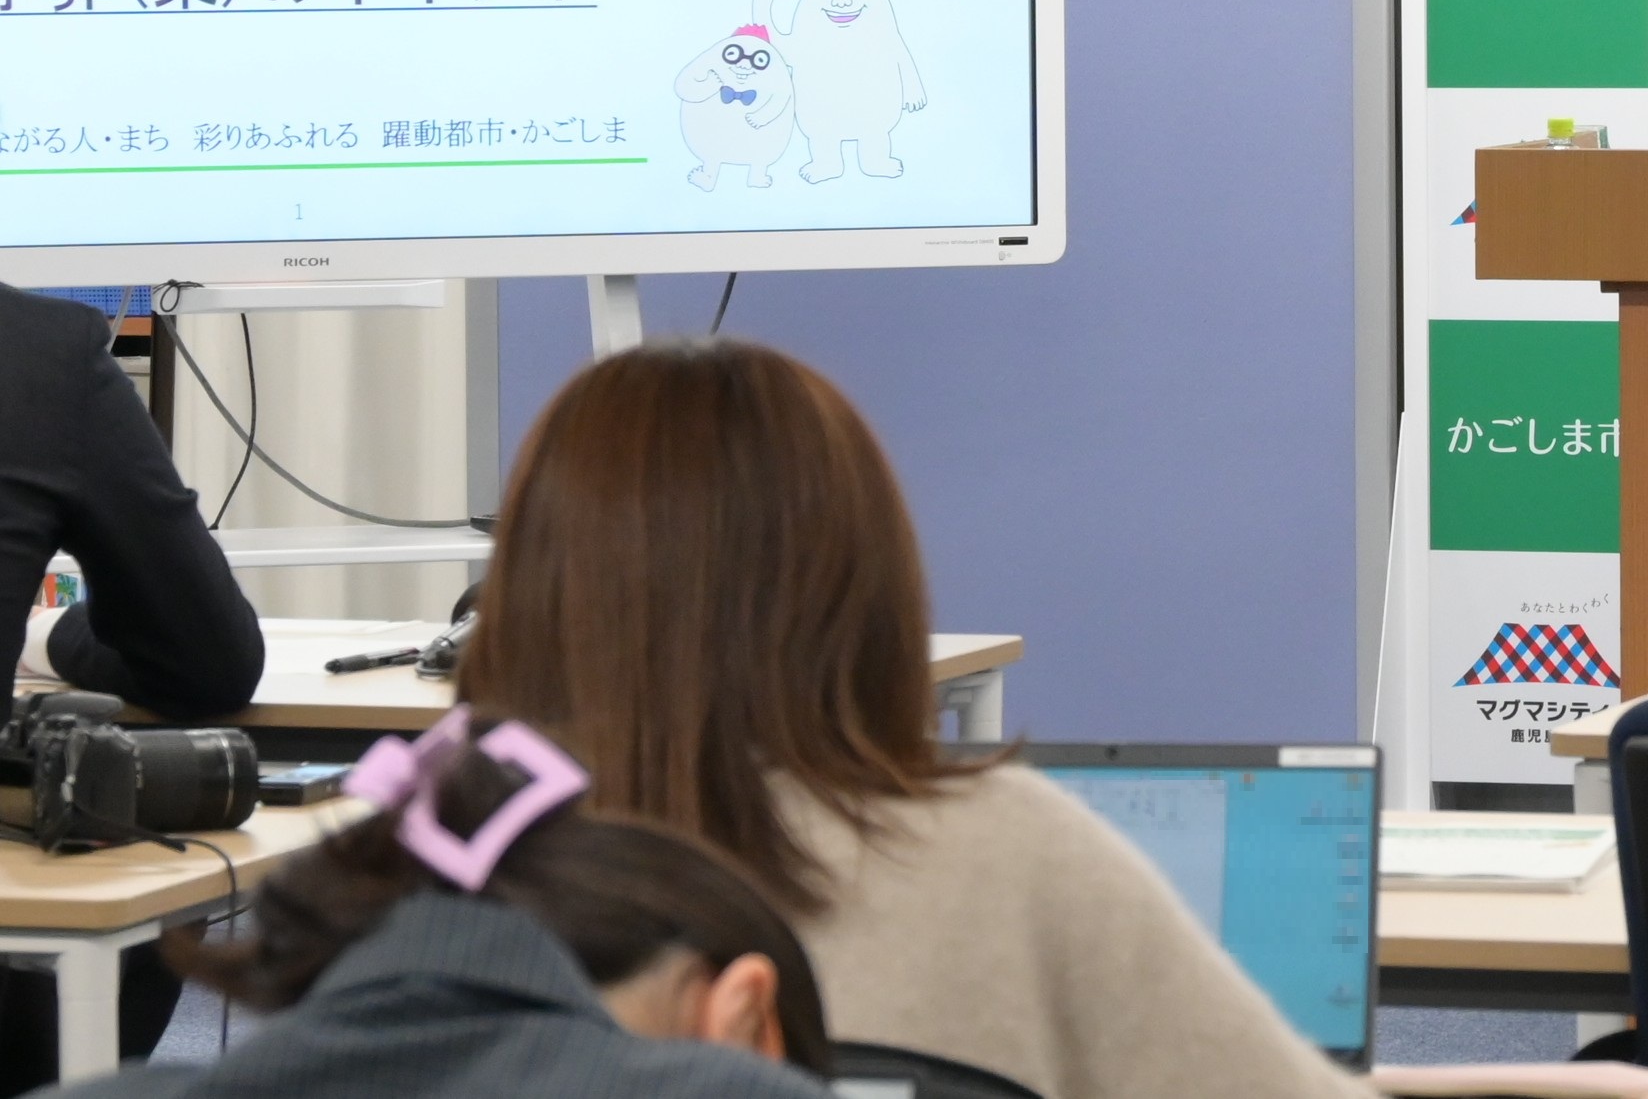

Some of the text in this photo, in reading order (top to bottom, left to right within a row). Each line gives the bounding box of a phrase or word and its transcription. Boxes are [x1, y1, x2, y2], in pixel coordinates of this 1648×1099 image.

[195, 123, 357, 151] 彩りあふれる
[296, 204, 303, 220] 1
[284, 258, 329, 266] RICOH
[1520, 593, 1610, 614] あなたとわくわく
